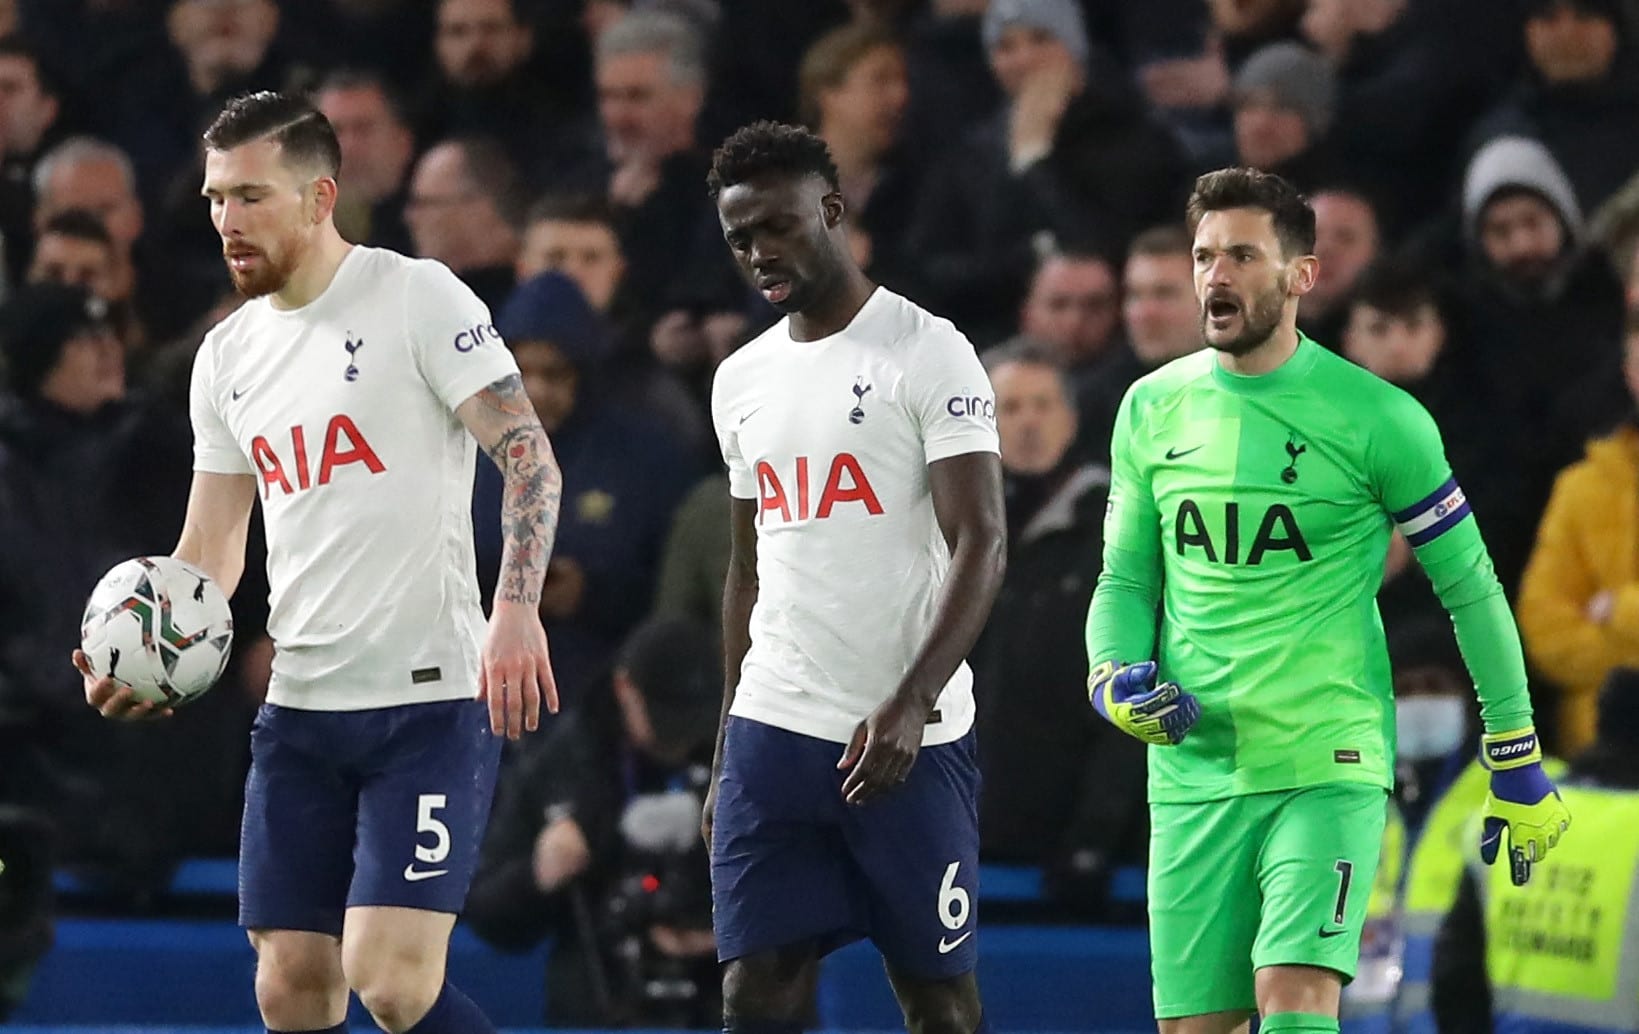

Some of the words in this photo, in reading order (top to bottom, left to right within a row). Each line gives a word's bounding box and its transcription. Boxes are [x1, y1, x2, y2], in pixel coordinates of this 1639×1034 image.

[251, 413, 386, 501] AIA
[757, 452, 884, 526] AIA
[1175, 499, 1313, 565] AIA
[1491, 740, 1534, 756] HUGO
[415, 794, 451, 863] 5
[938, 861, 970, 930] 6
[1333, 859, 1354, 926] 1
